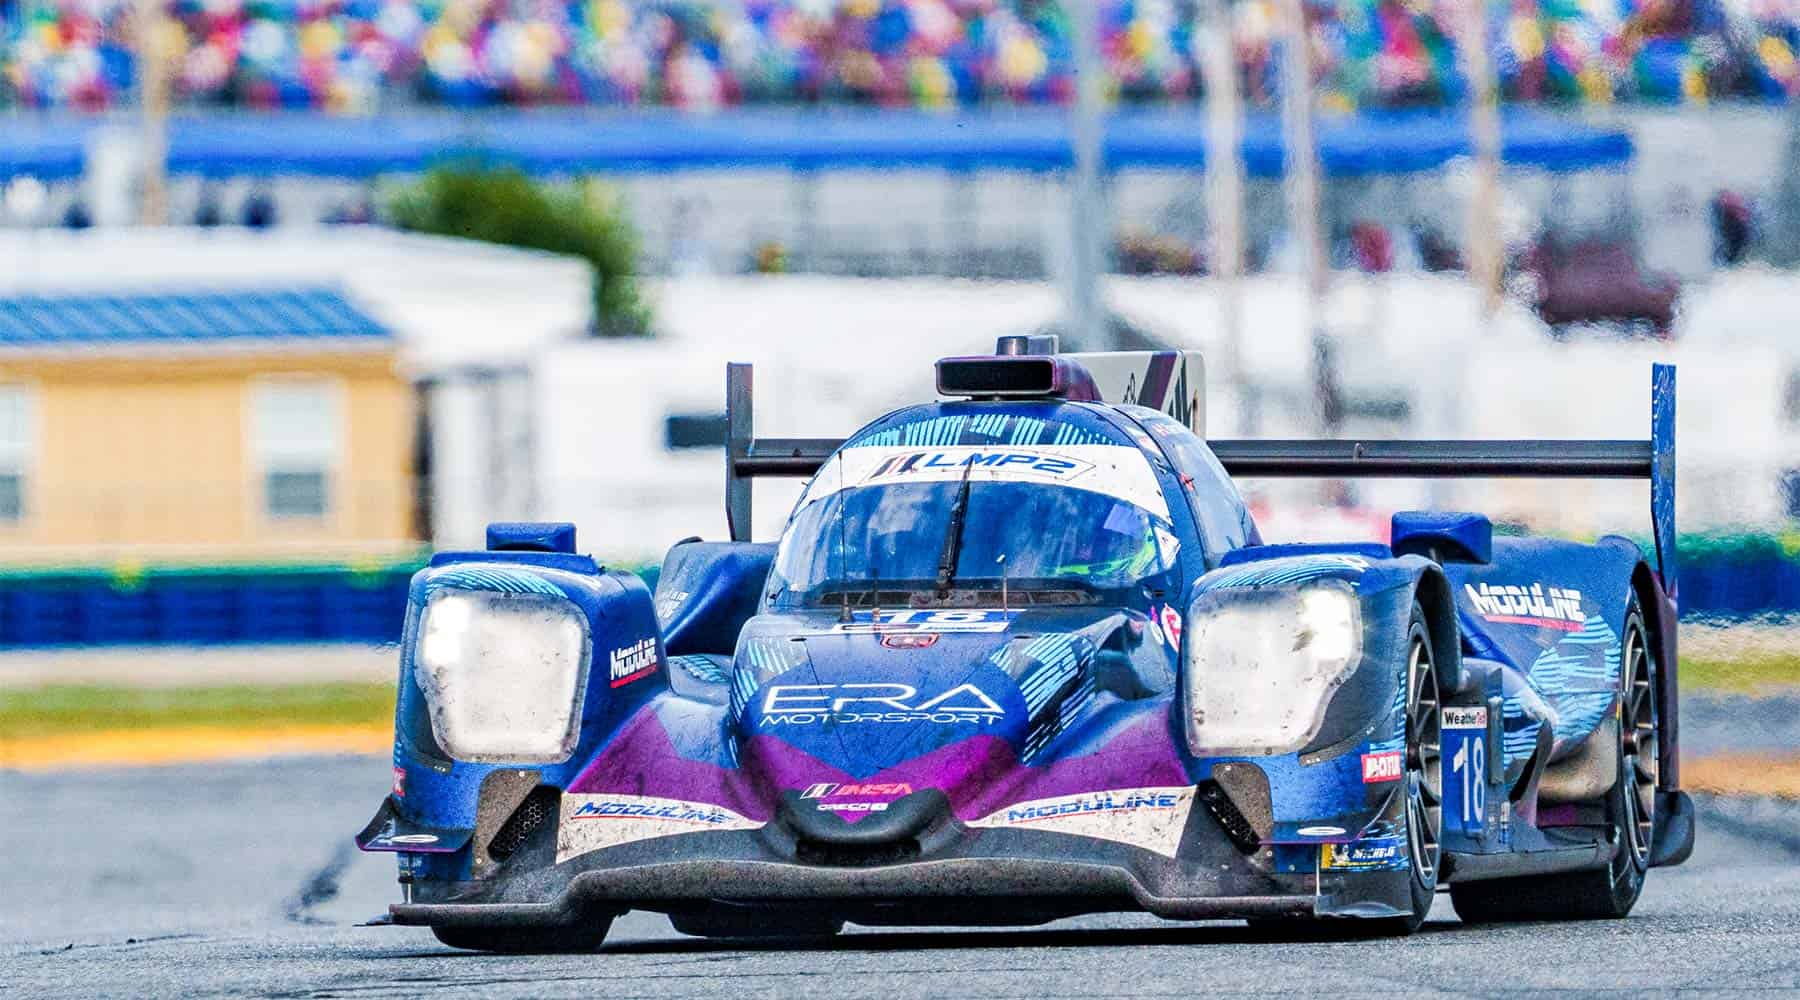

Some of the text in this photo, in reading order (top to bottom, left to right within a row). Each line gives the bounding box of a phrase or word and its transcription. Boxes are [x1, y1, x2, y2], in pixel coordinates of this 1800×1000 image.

[923, 453, 1076, 474] LMP2
[1464, 582, 1585, 622] MODULINE
[876, 609, 988, 624] 18
[763, 683, 1005, 713] ERA
[760, 713, 1004, 728] MOTORSPORT
[1444, 711, 1486, 725] WeatherT
[1453, 736, 1485, 823] 18
[576, 802, 730, 824] MODULINE
[1008, 795, 1176, 821] MODULINE
